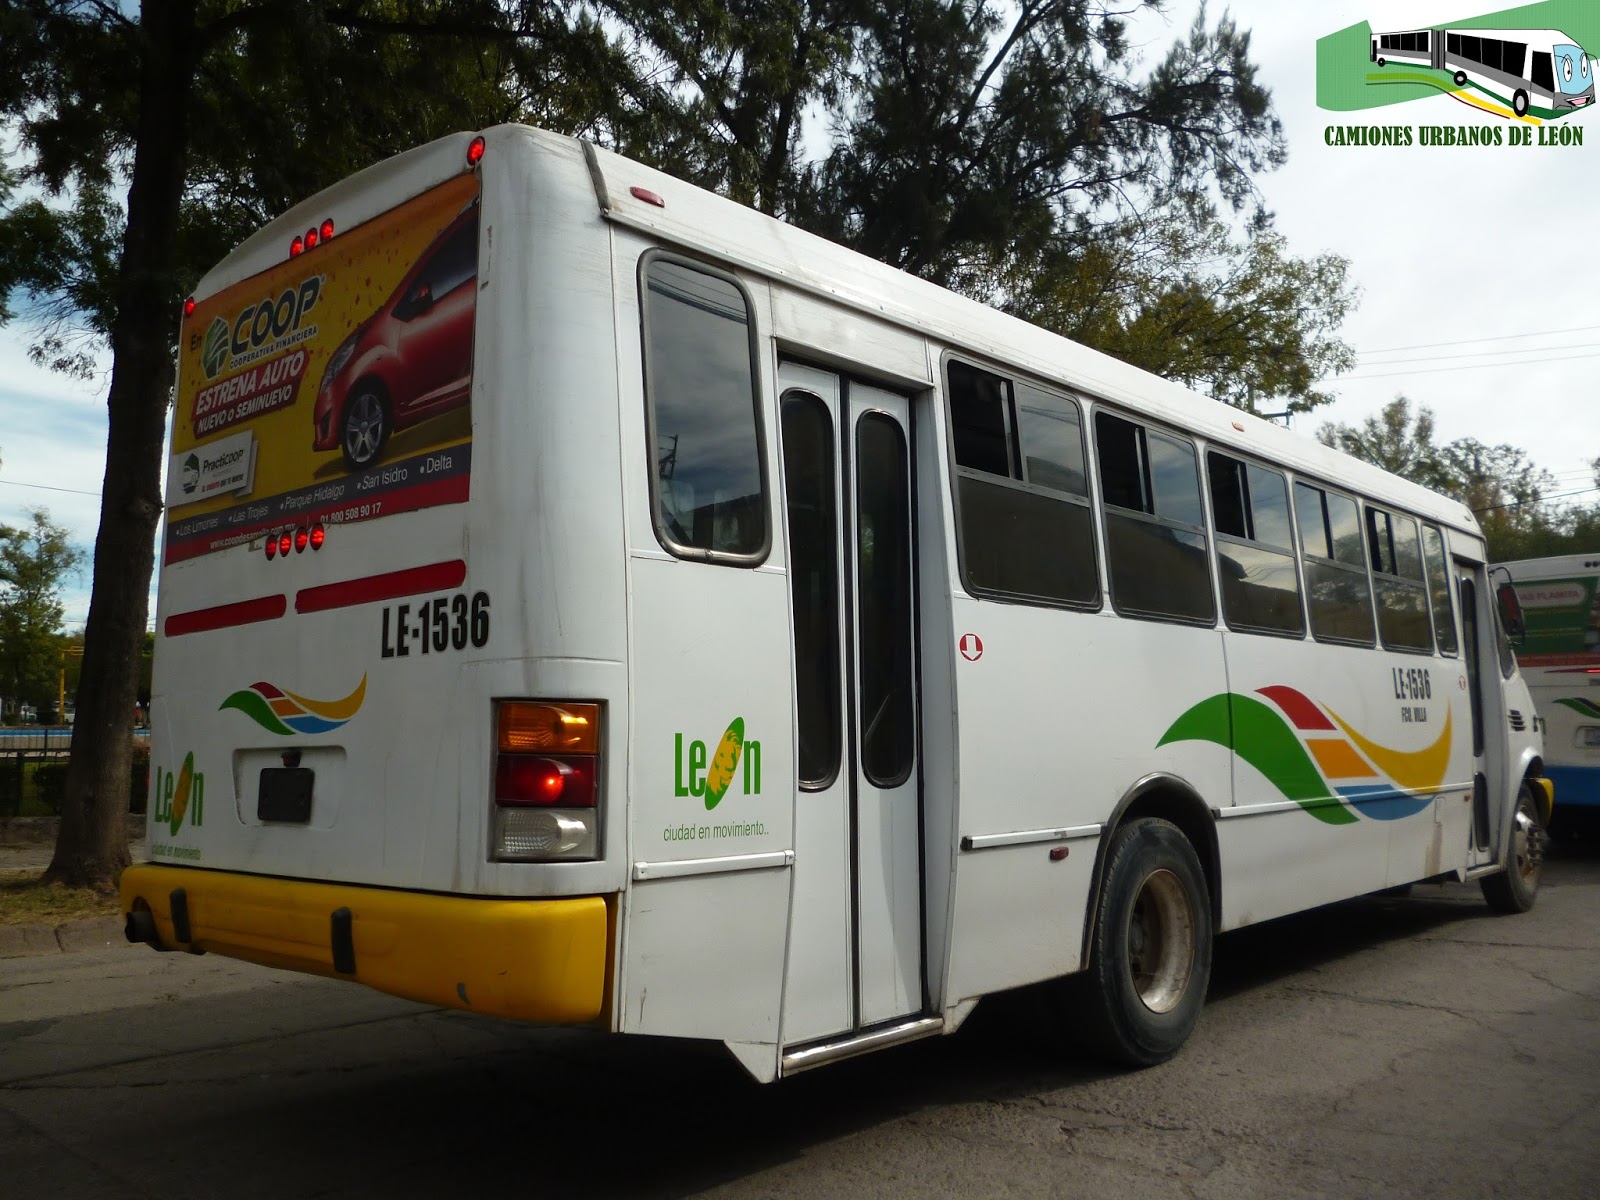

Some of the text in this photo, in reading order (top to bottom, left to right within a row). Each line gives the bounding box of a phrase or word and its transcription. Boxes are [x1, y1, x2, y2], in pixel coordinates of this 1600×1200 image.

[231, 276, 322, 356] COOP
[229, 326, 318, 369] COOPERATIVA FINANCIERA
[196, 351, 305, 415] ESTRENA AUTO
[197, 409, 227, 433] NUEVO
[235, 384, 293, 419] SEMINUEVO
[180, 455, 453, 537] Los Limones Las Trojes Parque Hidalgo San Isidro Delta
[330, 509, 344, 522] 800
[345, 506, 359, 520] 508
[360, 504, 370, 517] 90
[372, 502, 382, 514] 17
[381, 591, 490, 658] LE-1536
[1392, 667, 1431, 700] LE-1536
[663, 824, 696, 841] ciudad
[698, 826, 710, 839] en
